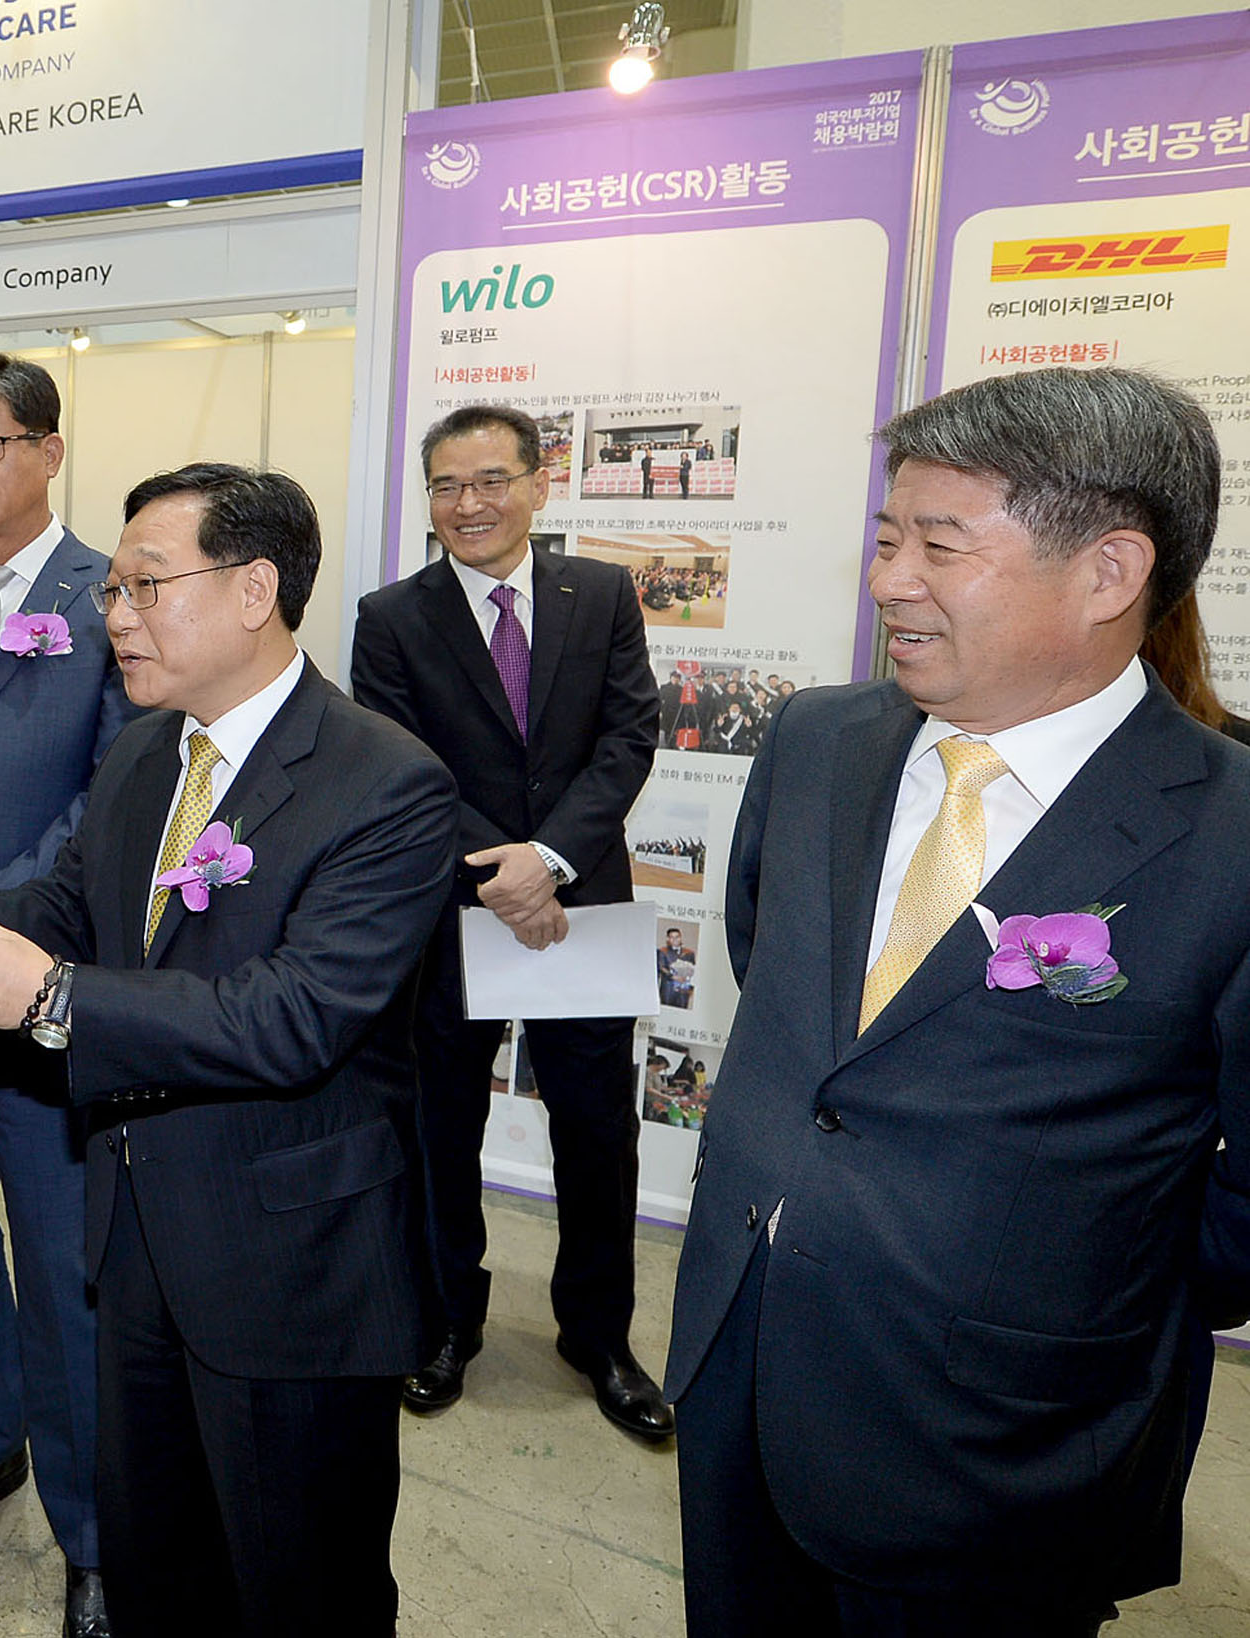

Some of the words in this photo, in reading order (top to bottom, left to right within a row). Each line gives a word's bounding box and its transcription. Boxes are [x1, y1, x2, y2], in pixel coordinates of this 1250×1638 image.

[49, 92, 144, 130] KOREA
[869, 90, 902, 105] 2017
[815, 104, 901, 126] 외국인투자기업
[813, 119, 900, 146] 채용박람회
[500, 159, 792, 217] 사회공헌(CSR)활동
[1021, 236, 1196, 274] DHL
[4, 264, 113, 290] Company
[441, 264, 555, 313] wilo
[439, 327, 498, 345] 윌로펌프
